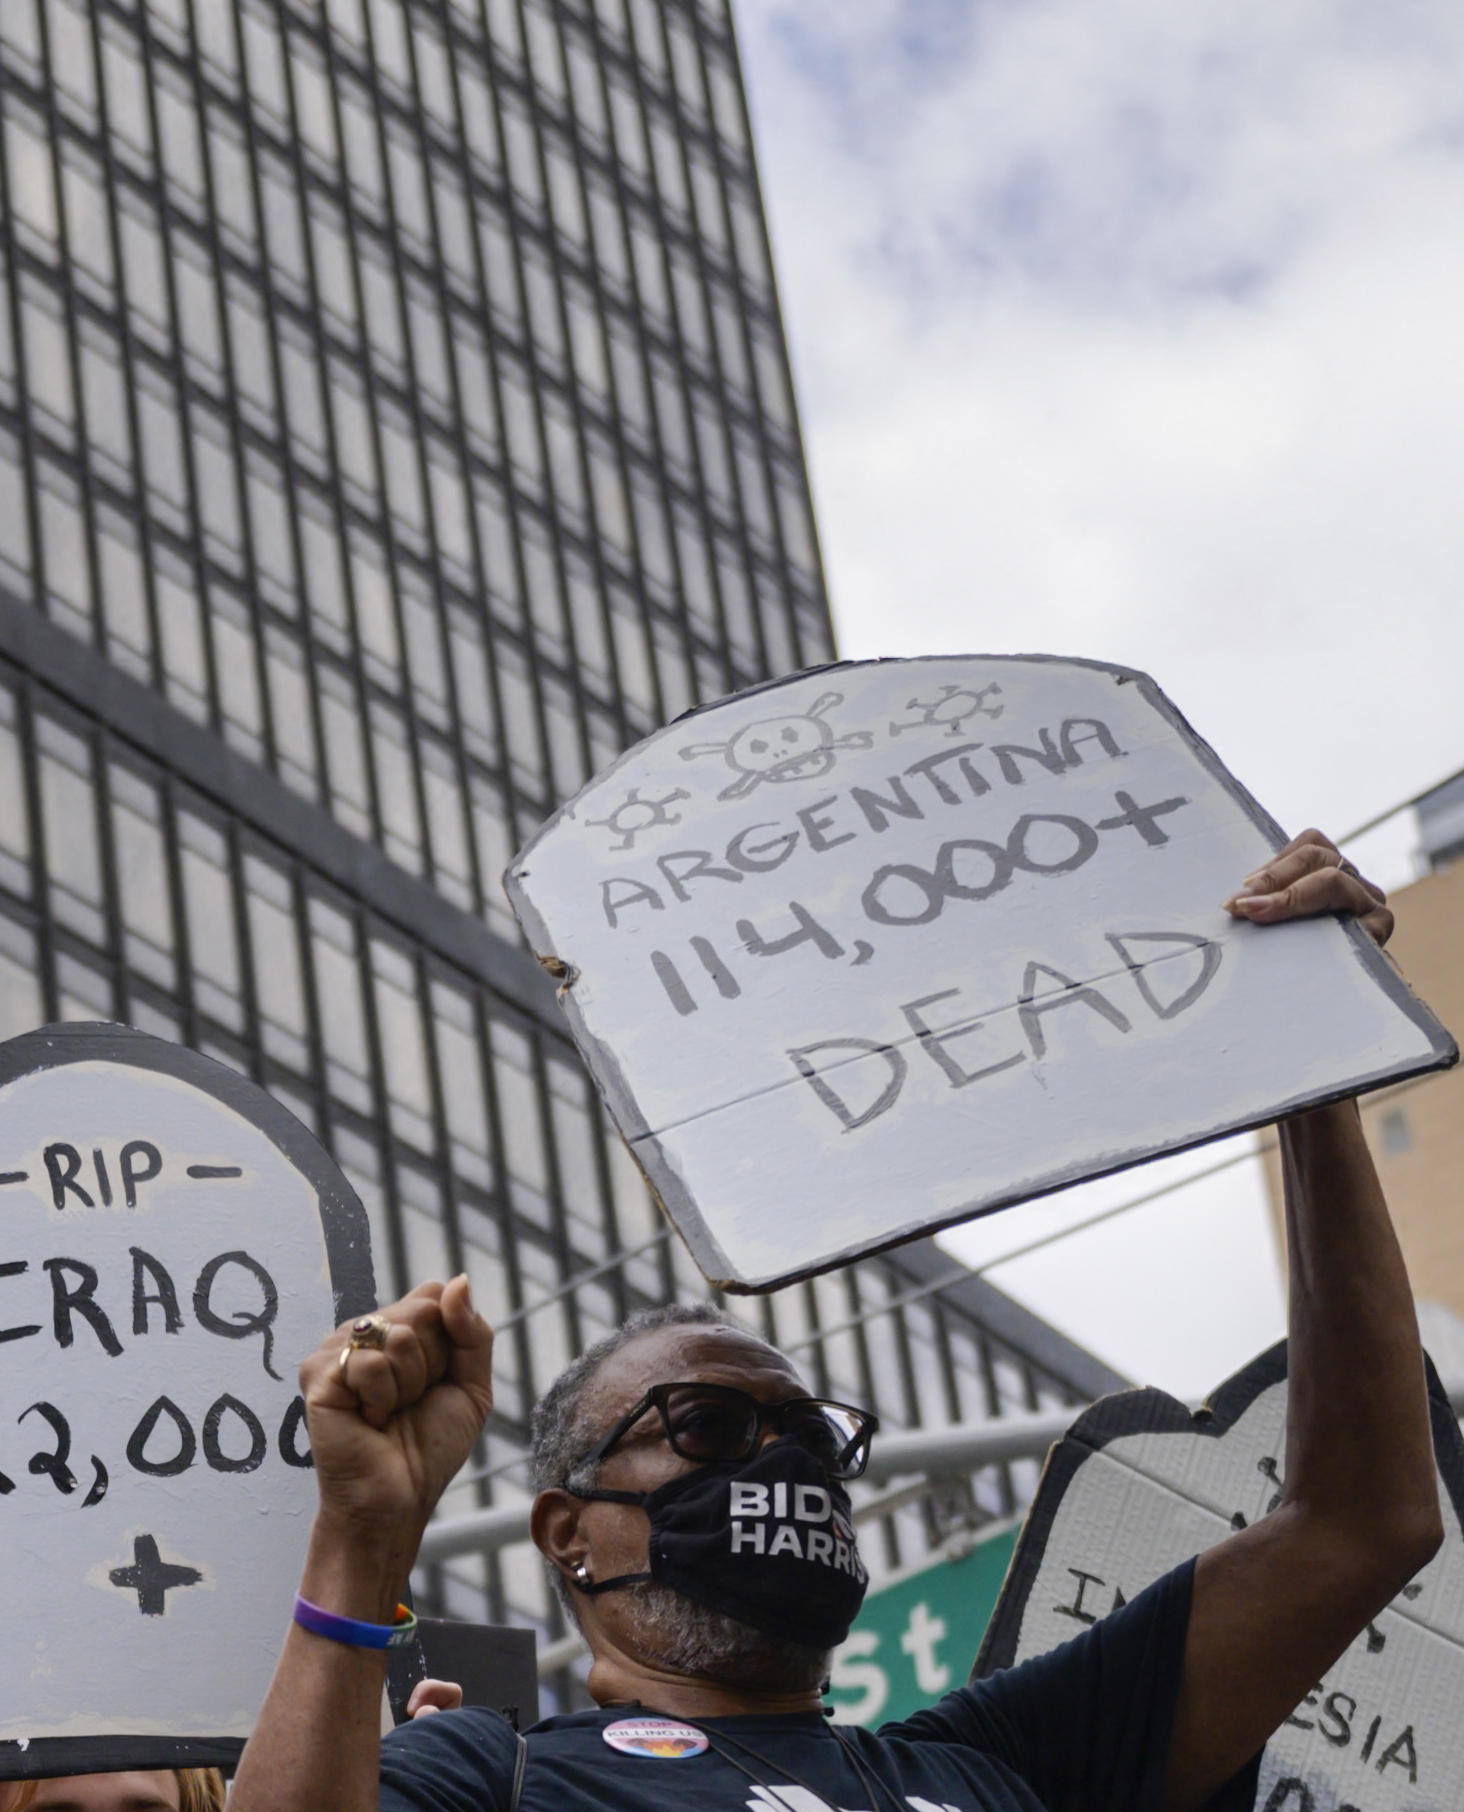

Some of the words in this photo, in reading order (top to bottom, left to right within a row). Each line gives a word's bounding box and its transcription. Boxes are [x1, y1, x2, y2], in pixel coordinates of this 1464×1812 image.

[599, 717, 1128, 928] ARGENTINA
[650, 790, 1192, 1016] 114,000+
[787, 931, 1223, 1135] DEAD
[730, 1481, 856, 1540] BID
[731, 1521, 869, 1585] HARRIS
[679, 1730, 705, 1738] US
